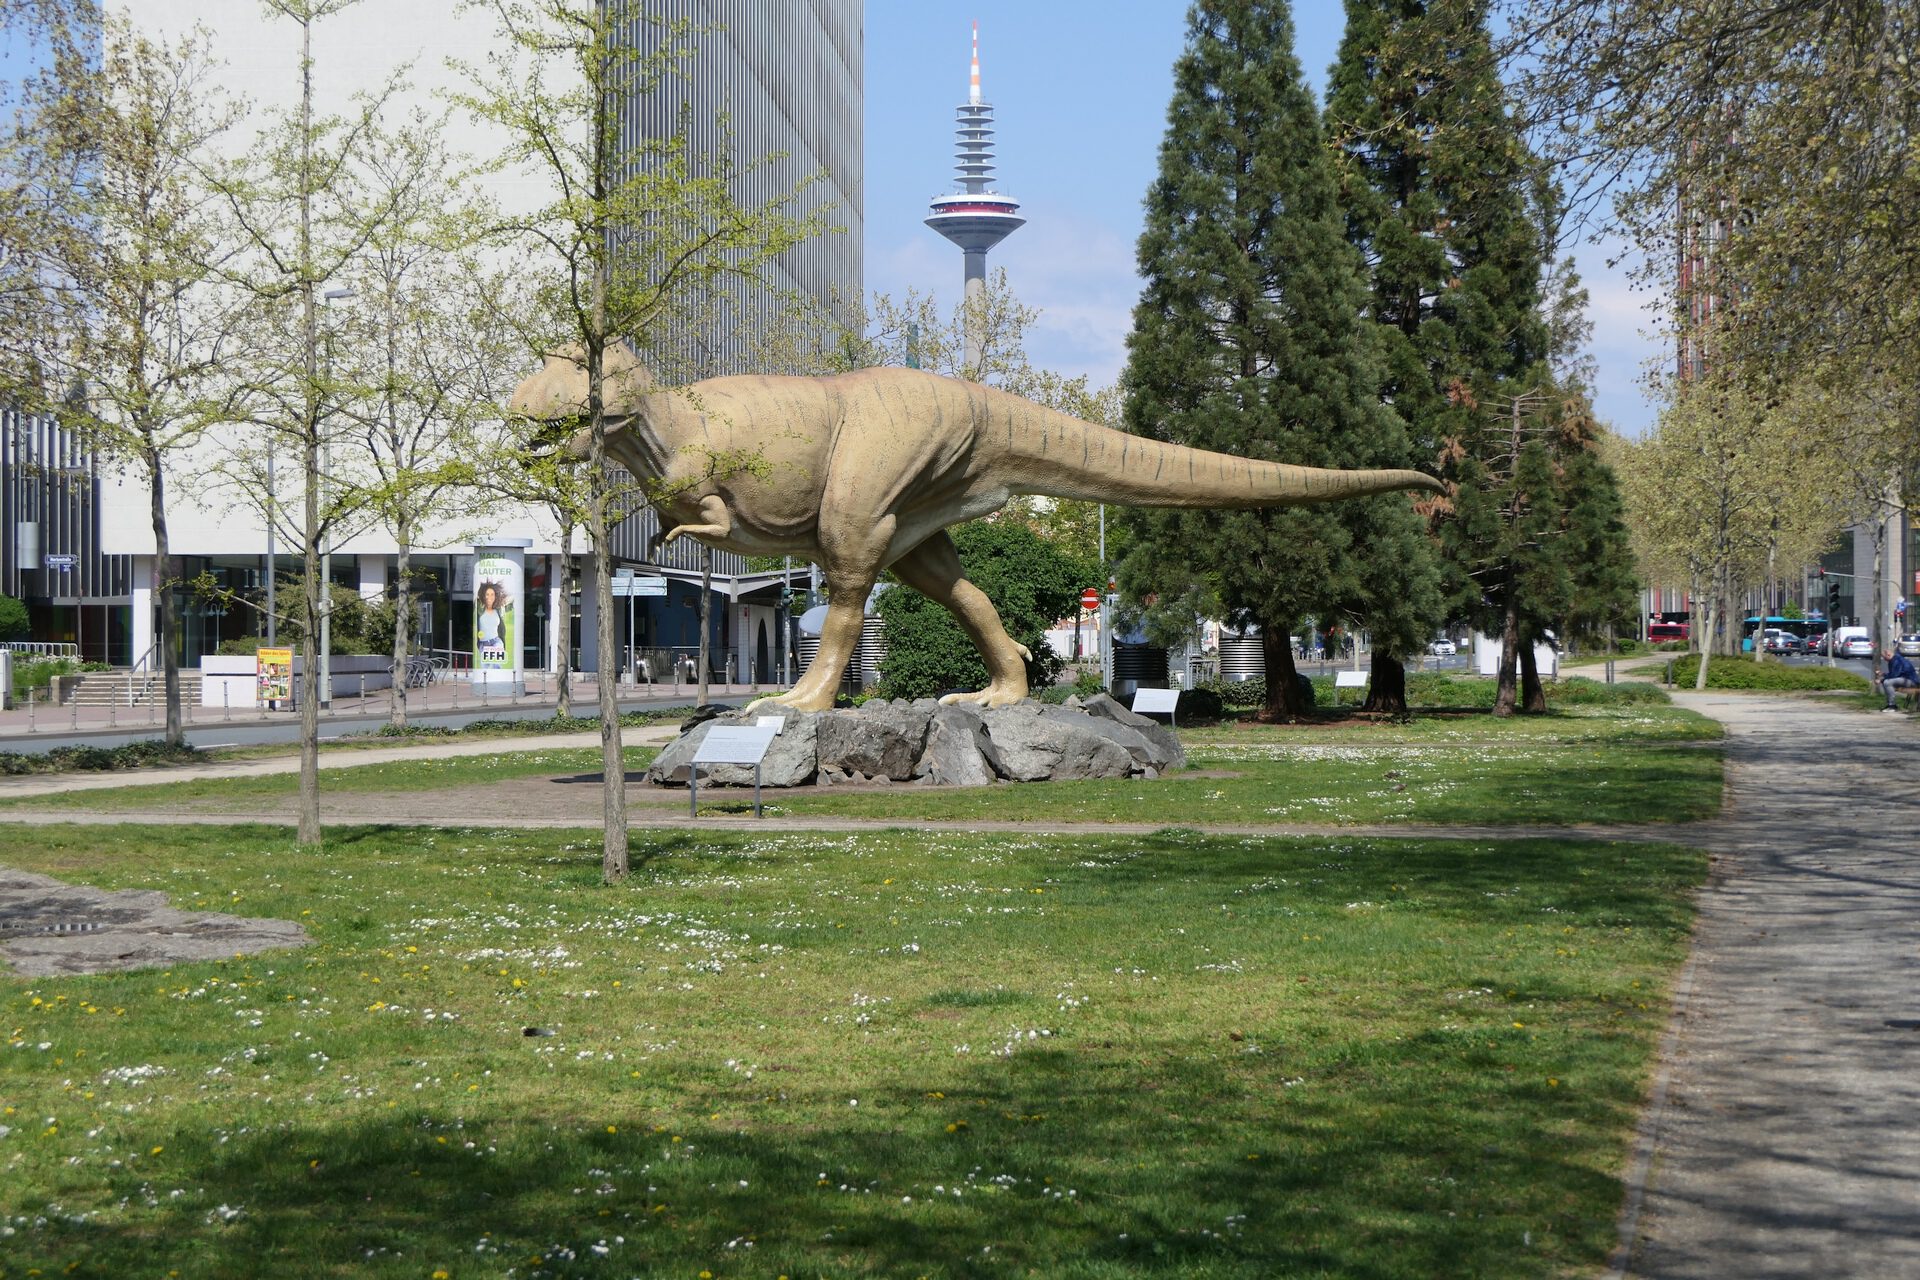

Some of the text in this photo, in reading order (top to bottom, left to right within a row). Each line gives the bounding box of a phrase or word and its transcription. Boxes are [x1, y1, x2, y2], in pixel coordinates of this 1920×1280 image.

[479, 552, 506, 560] MACH
[479, 560, 497, 568] MAL
[479, 568, 513, 576] LAUTER
[483, 651, 505, 661] FFH
